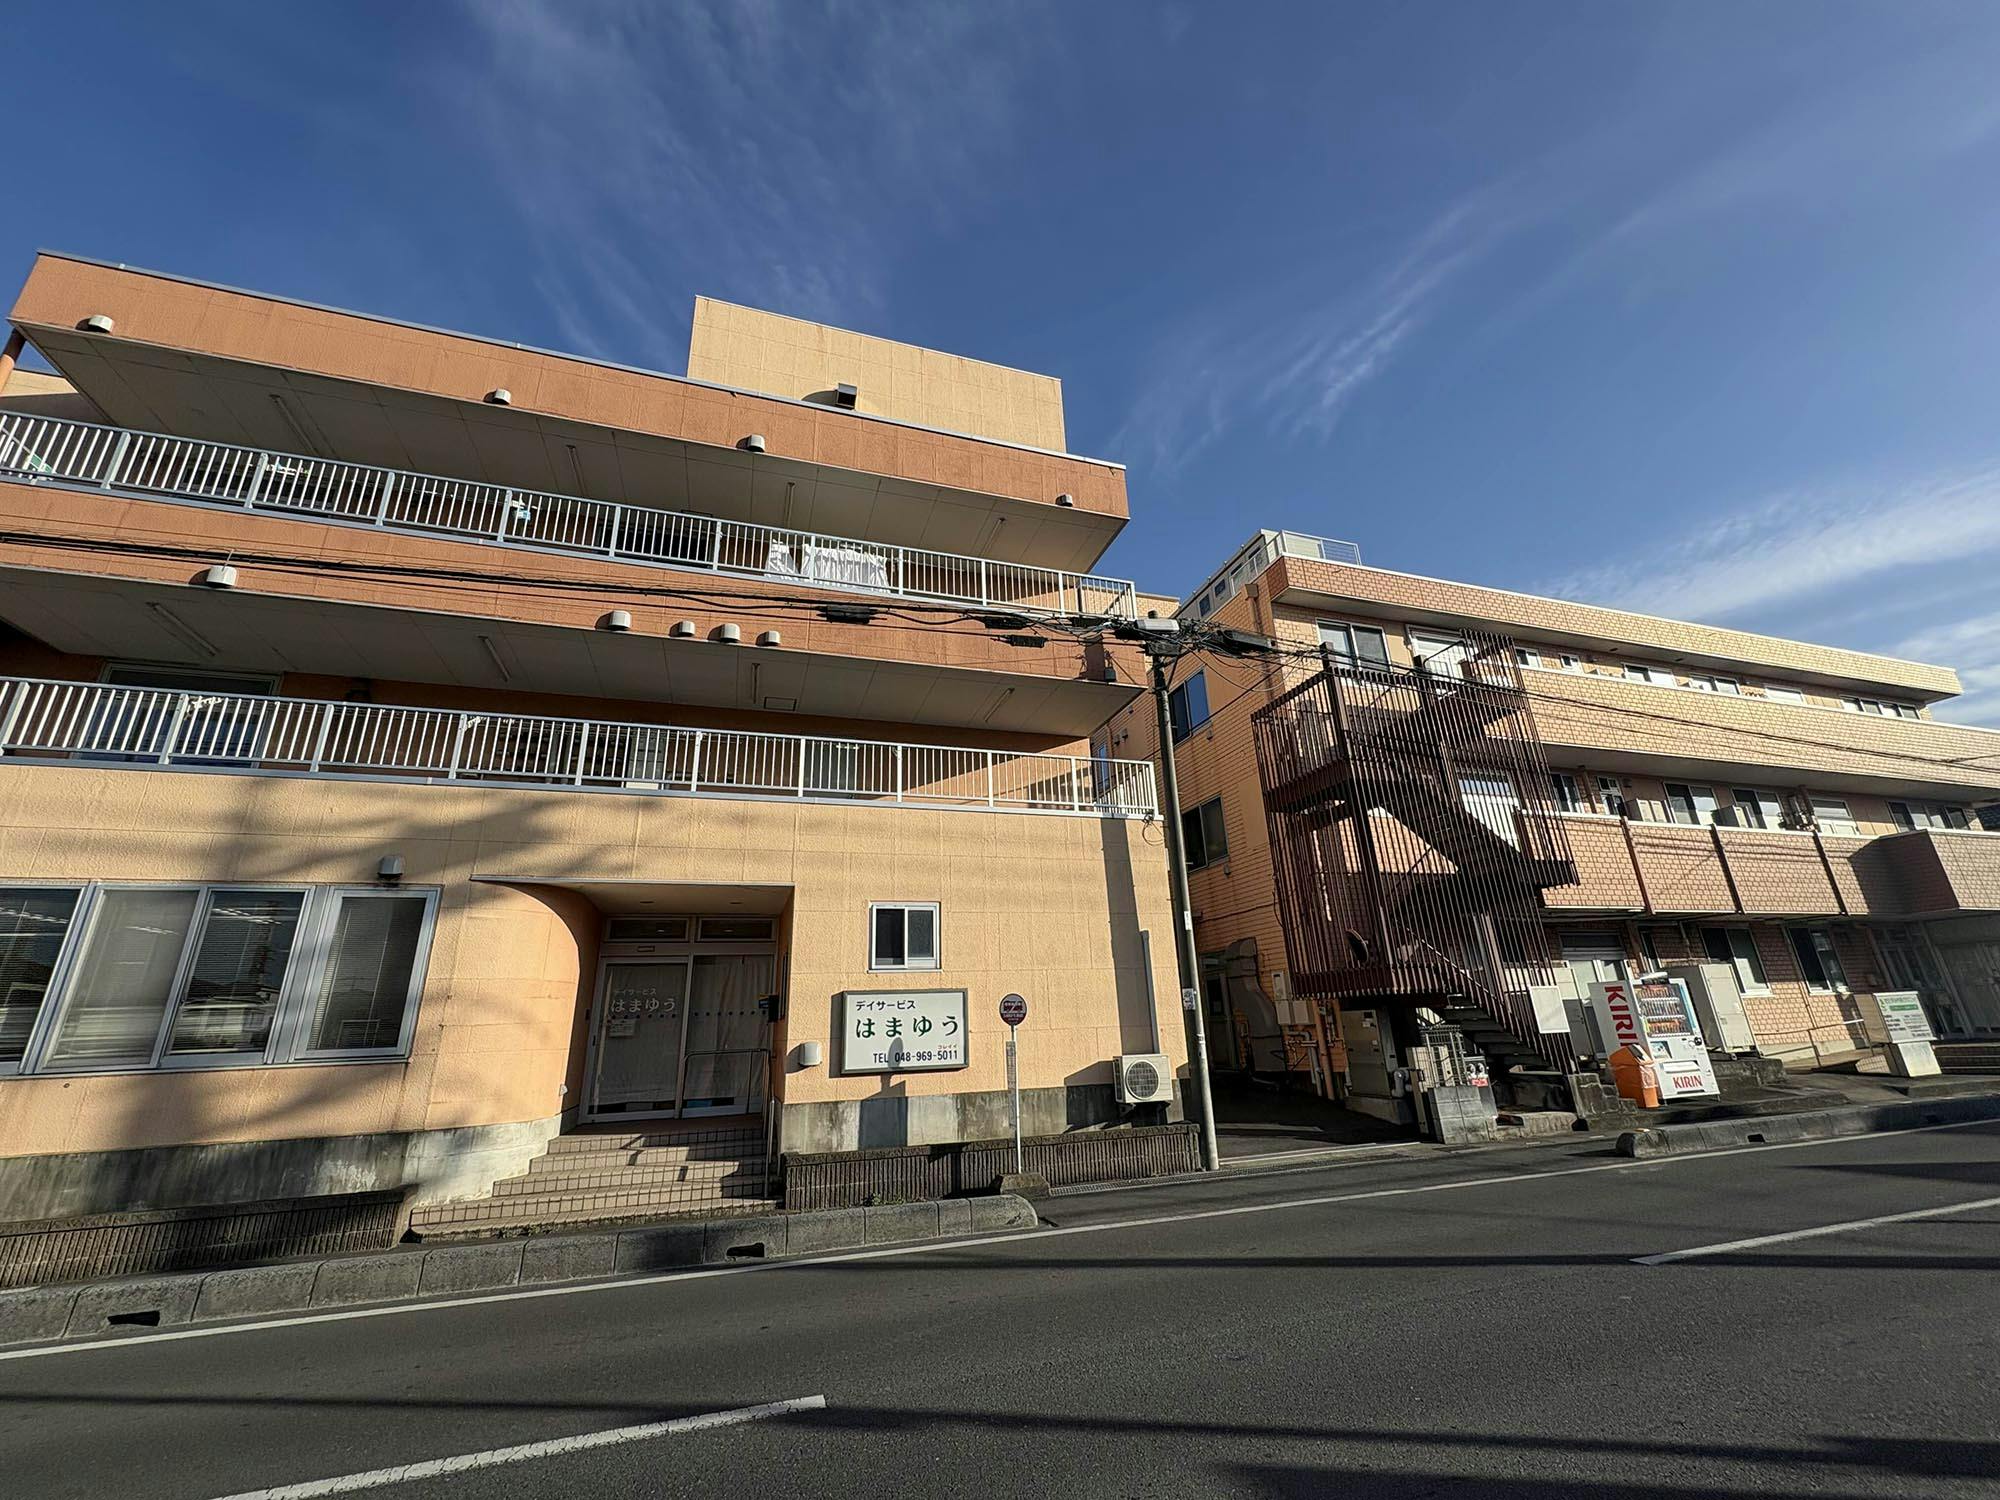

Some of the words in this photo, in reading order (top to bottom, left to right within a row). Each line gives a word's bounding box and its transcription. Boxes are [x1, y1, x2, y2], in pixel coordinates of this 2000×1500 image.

[611, 998, 676, 1013] はまゆう
[856, 1000, 916, 1011] デイサービス
[1604, 985, 1639, 1047] KIRI
[855, 1015, 959, 1038] はまゆう
[873, 1052, 889, 1064] TEL
[894, 1049, 958, 1063] 048-969-5011
[1672, 1074, 1703, 1089] KIRIN
